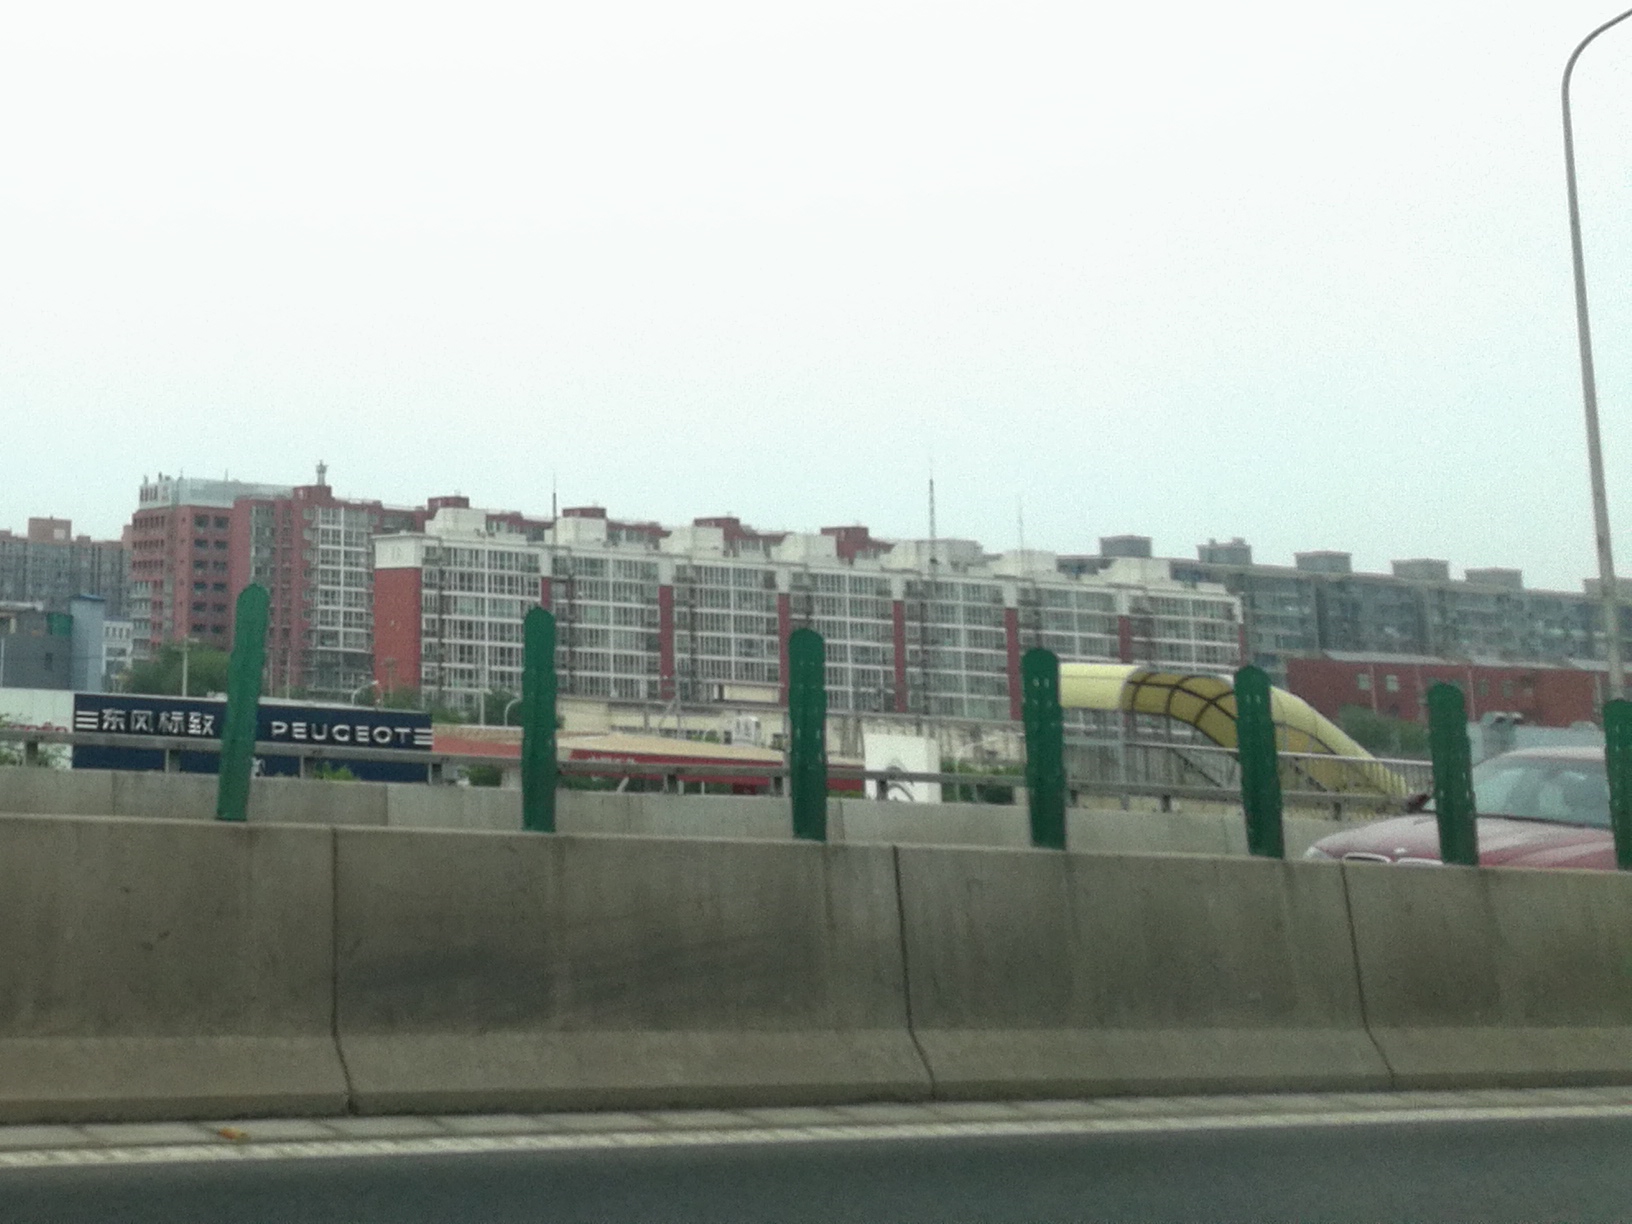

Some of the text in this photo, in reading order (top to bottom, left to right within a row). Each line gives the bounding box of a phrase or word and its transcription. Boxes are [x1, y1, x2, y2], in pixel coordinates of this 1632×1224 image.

[101, 708, 215, 736] 东风标致
[270, 720, 411, 745] PEUGEOT
